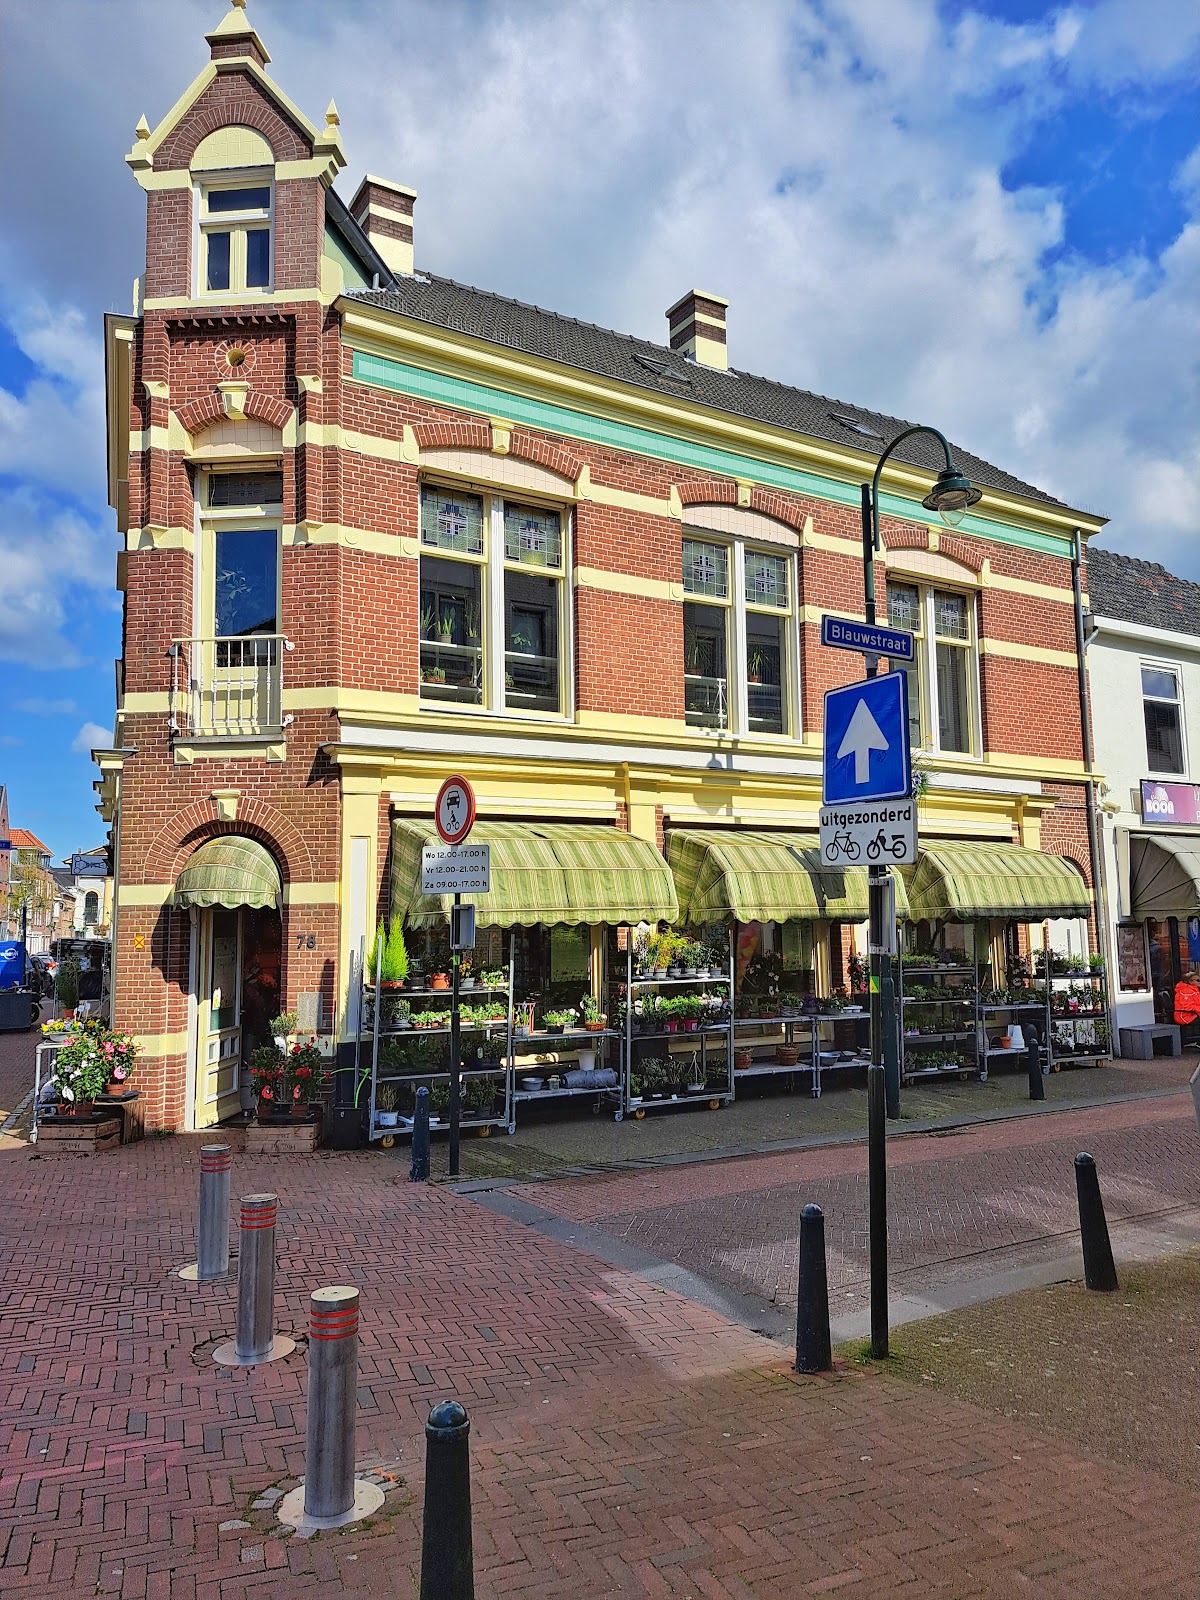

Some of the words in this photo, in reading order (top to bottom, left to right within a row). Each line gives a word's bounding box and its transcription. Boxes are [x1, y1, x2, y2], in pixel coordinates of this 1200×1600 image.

[831, 625, 907, 652] Blauwstraat
[821, 806, 911, 829] uitgezonderd
[437, 851, 480, 859] 12.00-17.00
[297, 934, 316, 949] 78
